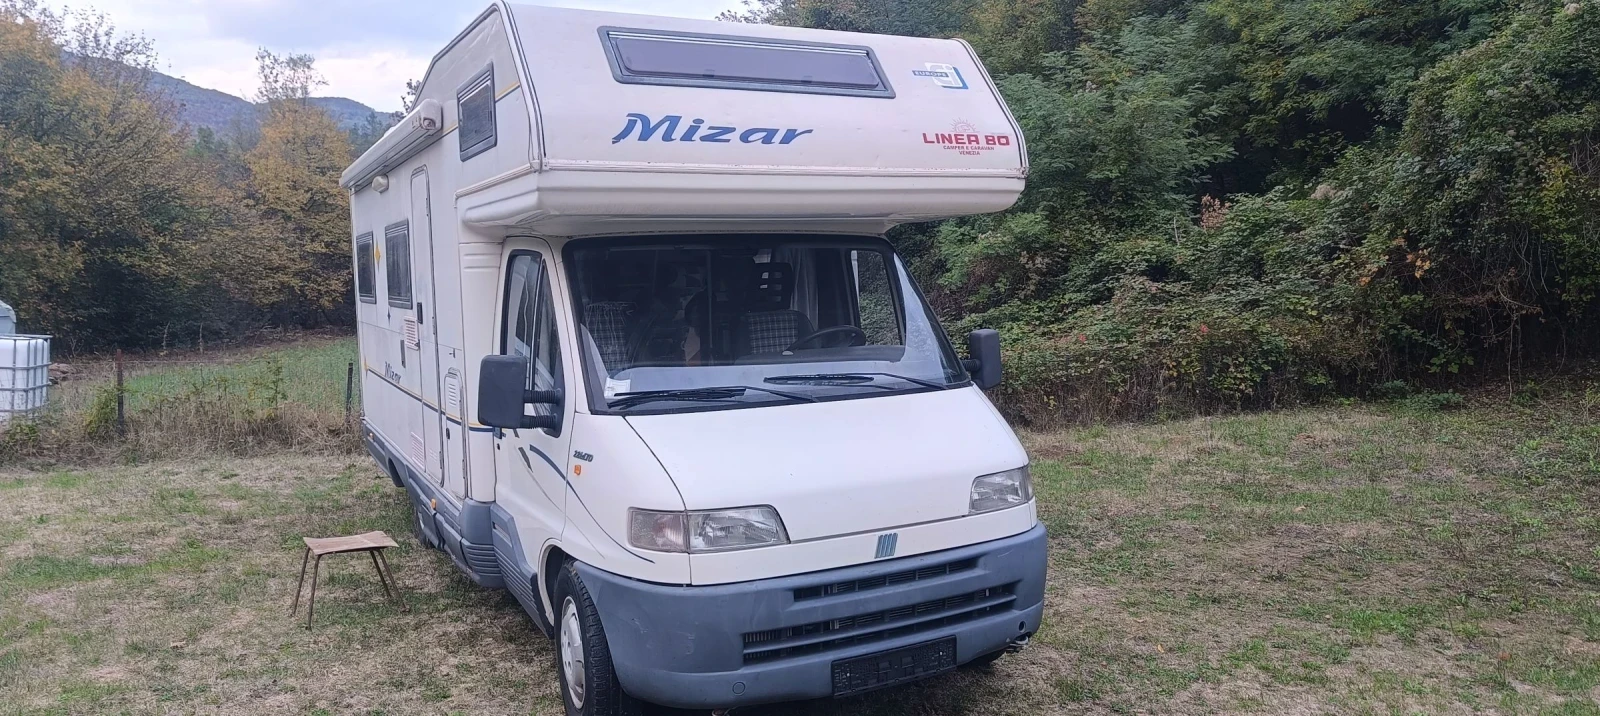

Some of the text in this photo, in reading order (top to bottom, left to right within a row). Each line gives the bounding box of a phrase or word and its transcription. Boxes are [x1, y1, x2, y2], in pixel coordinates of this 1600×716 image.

[611, 112, 814, 145] Mizar
[922, 132, 1010, 146] LINEA 80
